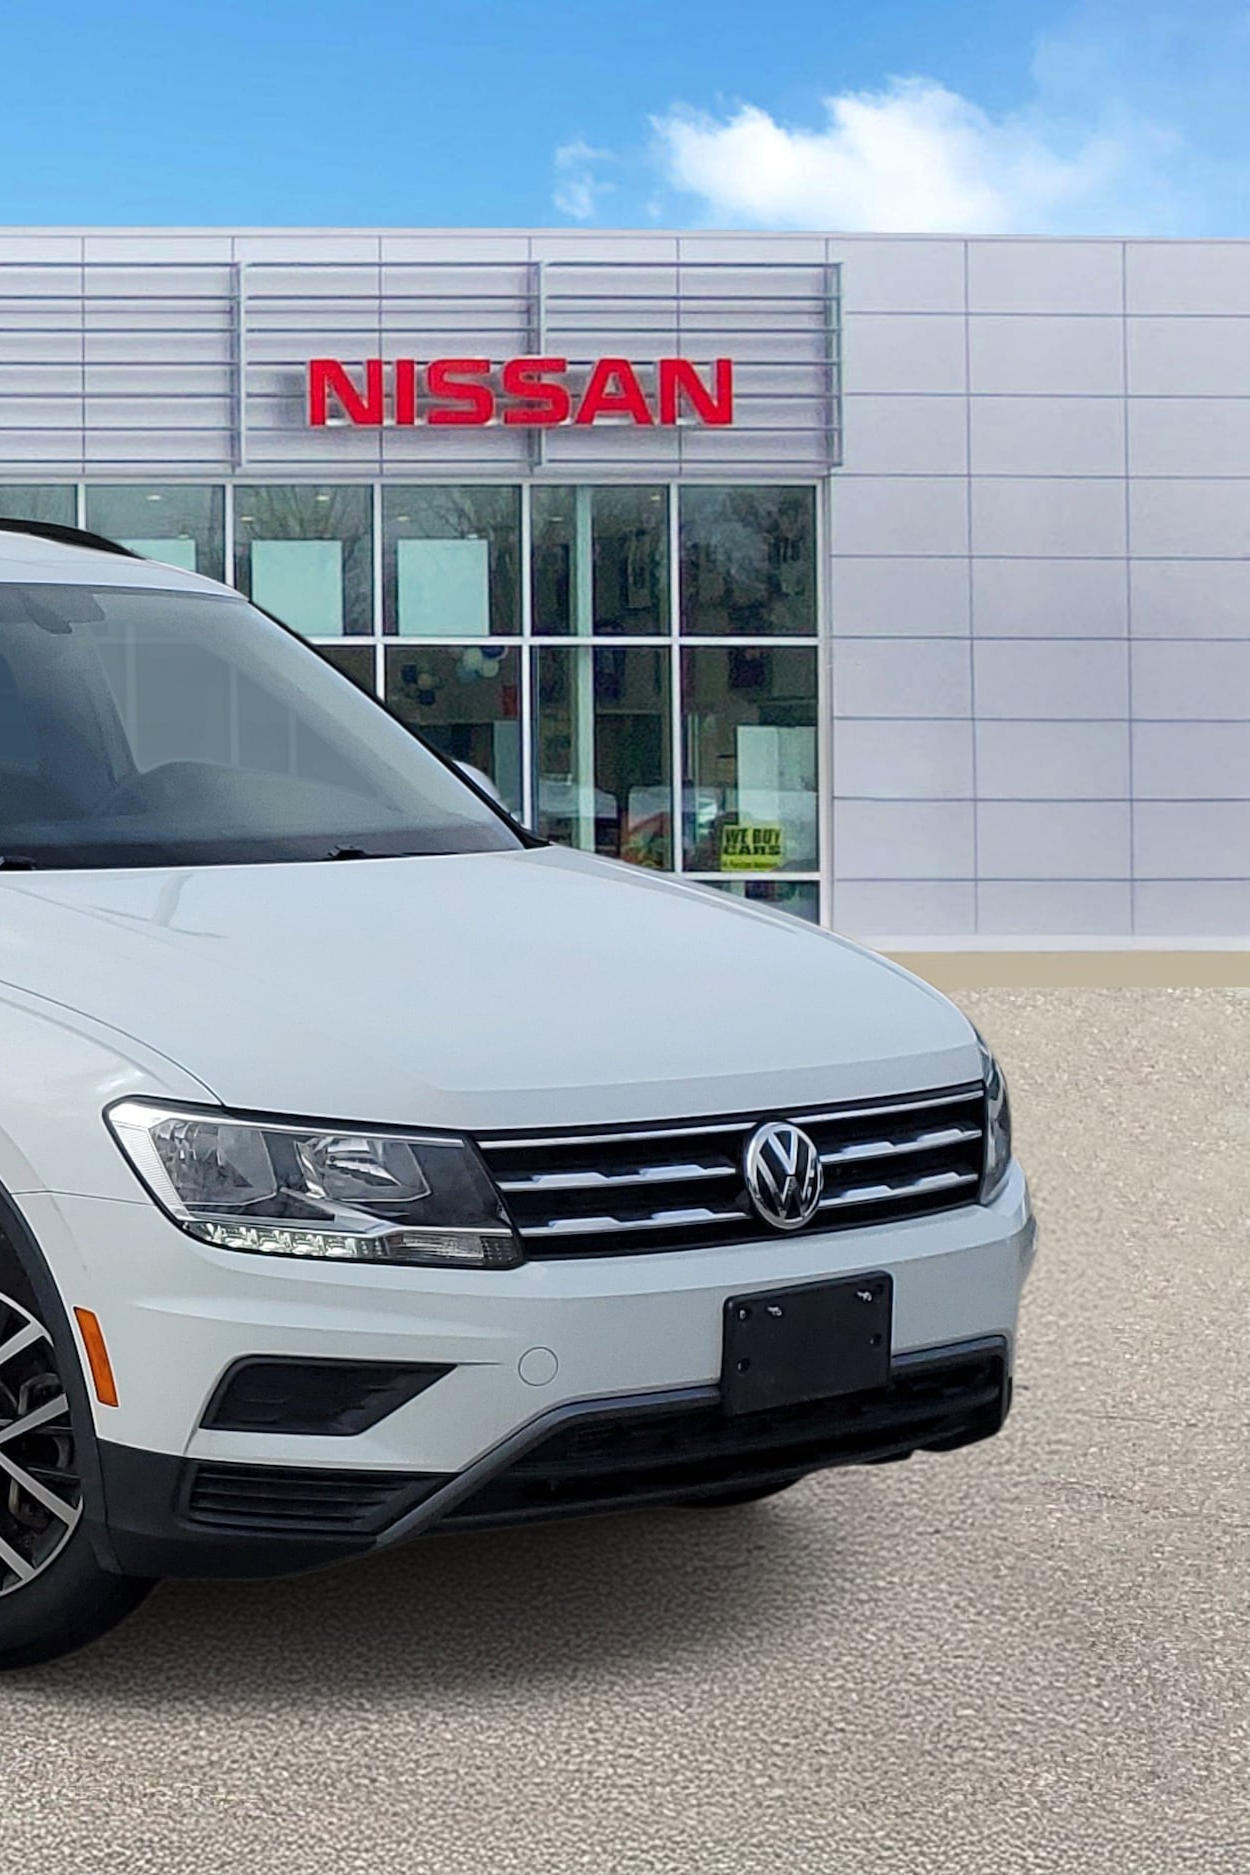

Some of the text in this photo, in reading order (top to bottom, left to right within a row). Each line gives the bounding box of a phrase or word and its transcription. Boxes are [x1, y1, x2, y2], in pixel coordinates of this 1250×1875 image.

[308, 358, 733, 425] NISSAN
[725, 828, 781, 844] WE BUY
[723, 845, 781, 855] CARS
